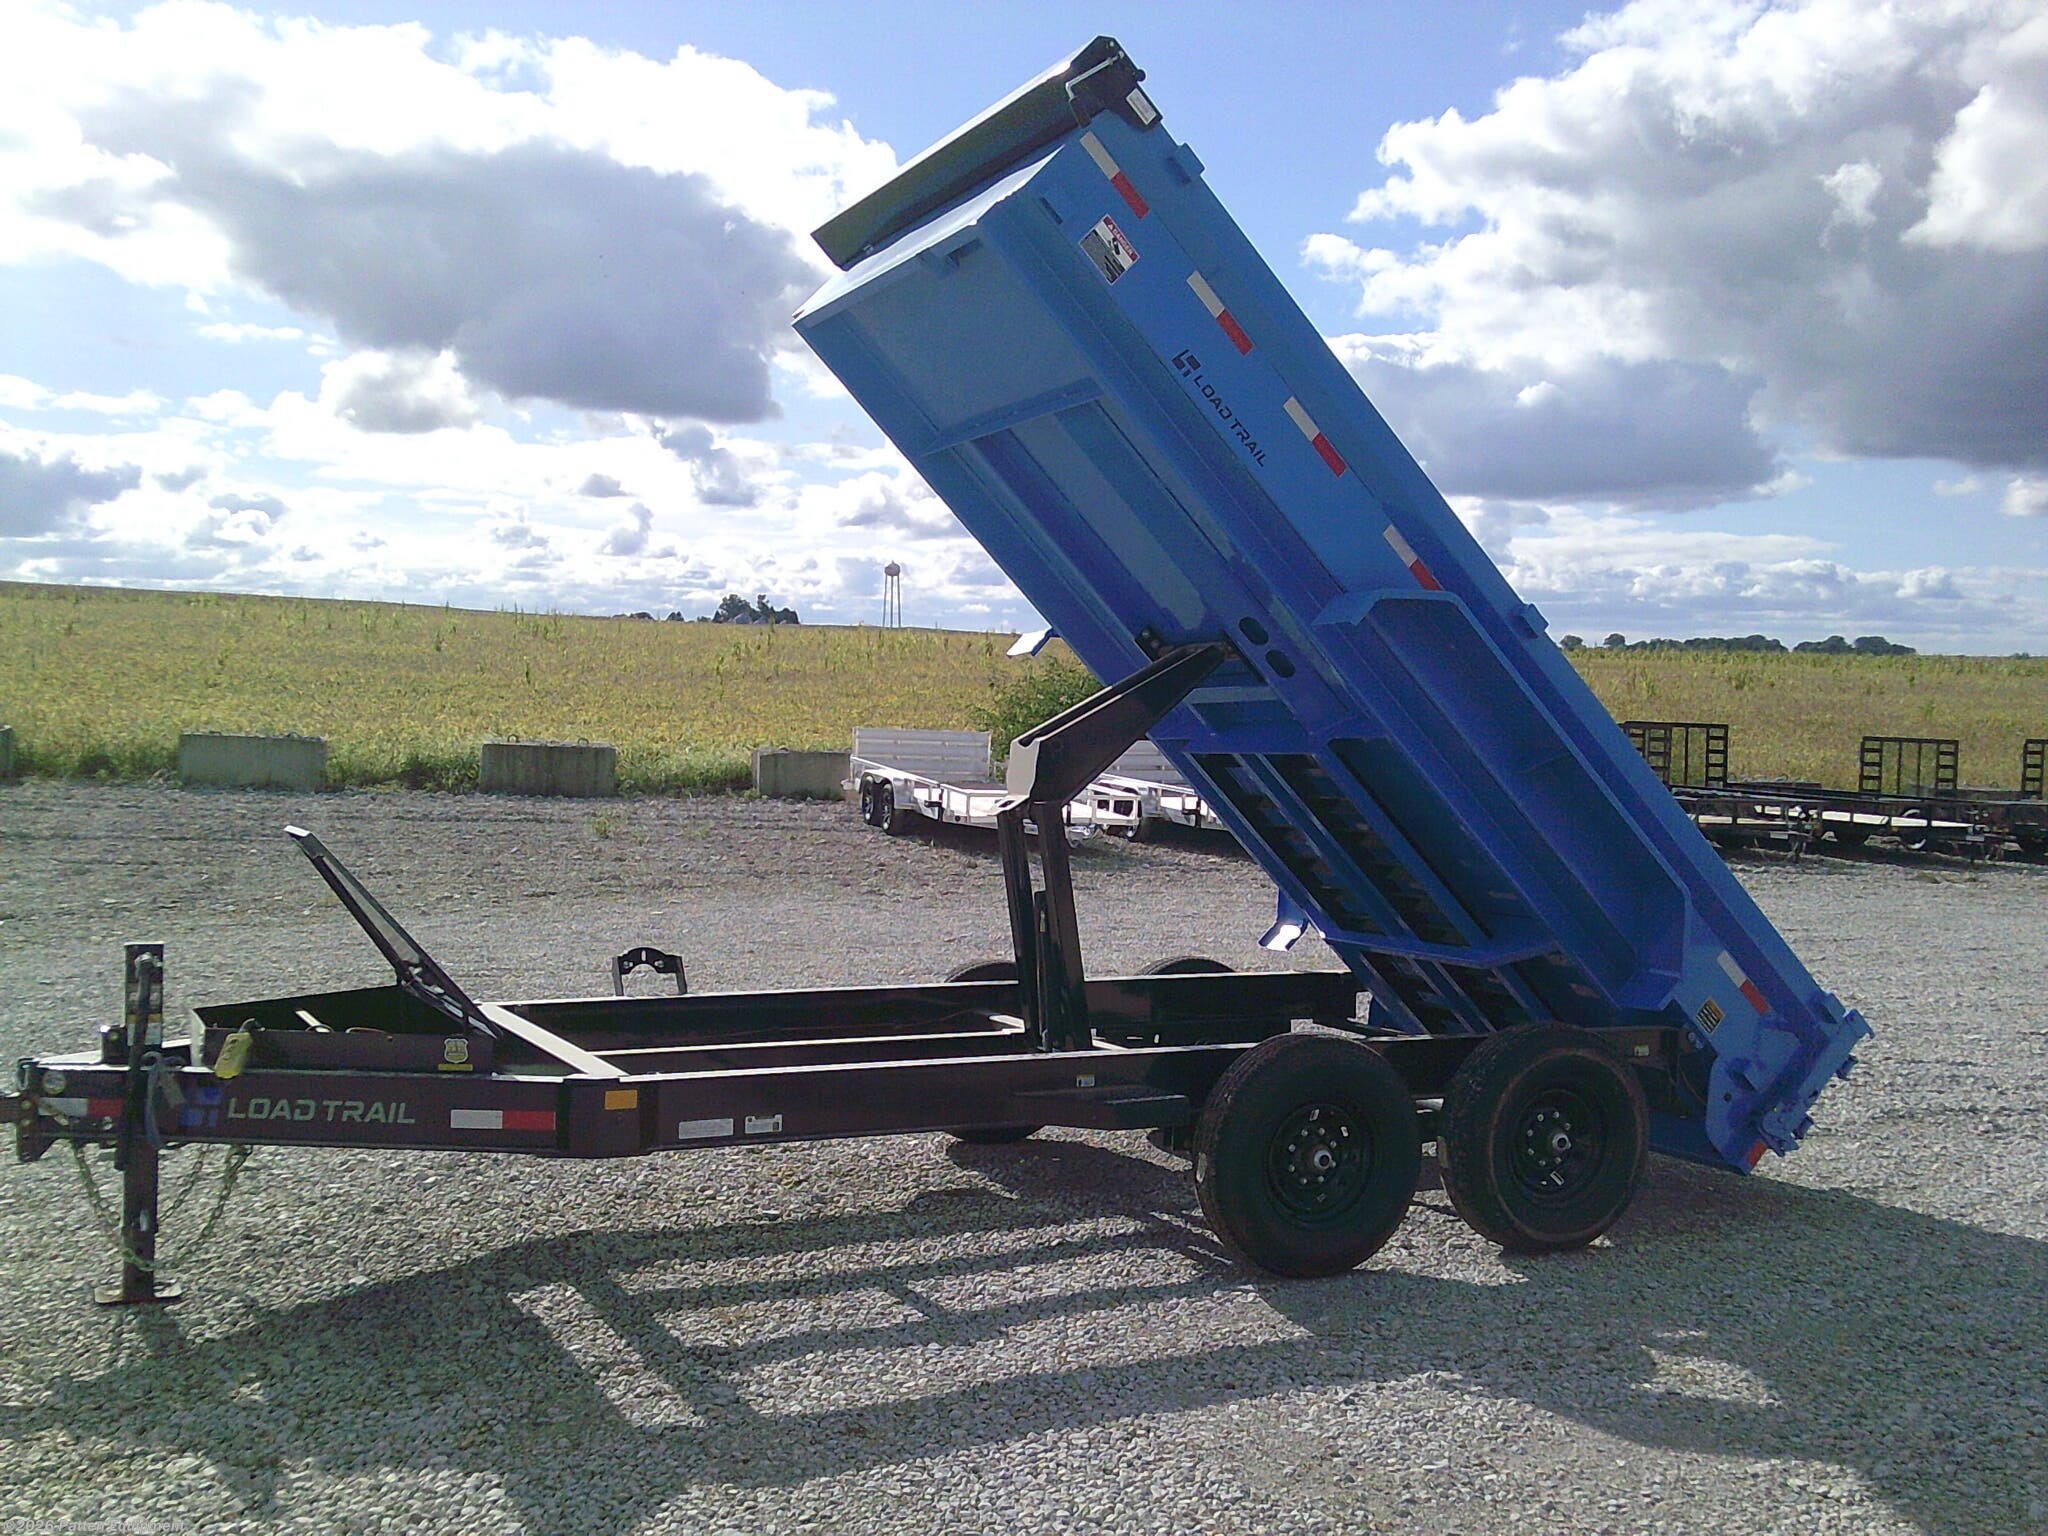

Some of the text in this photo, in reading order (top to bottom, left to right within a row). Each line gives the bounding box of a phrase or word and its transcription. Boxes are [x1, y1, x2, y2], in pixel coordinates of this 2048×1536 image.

[1194, 375, 1233, 420] LOAD
[1230, 418, 1266, 468] TRAIL
[227, 1098, 416, 1124] LOAD TRAIL
